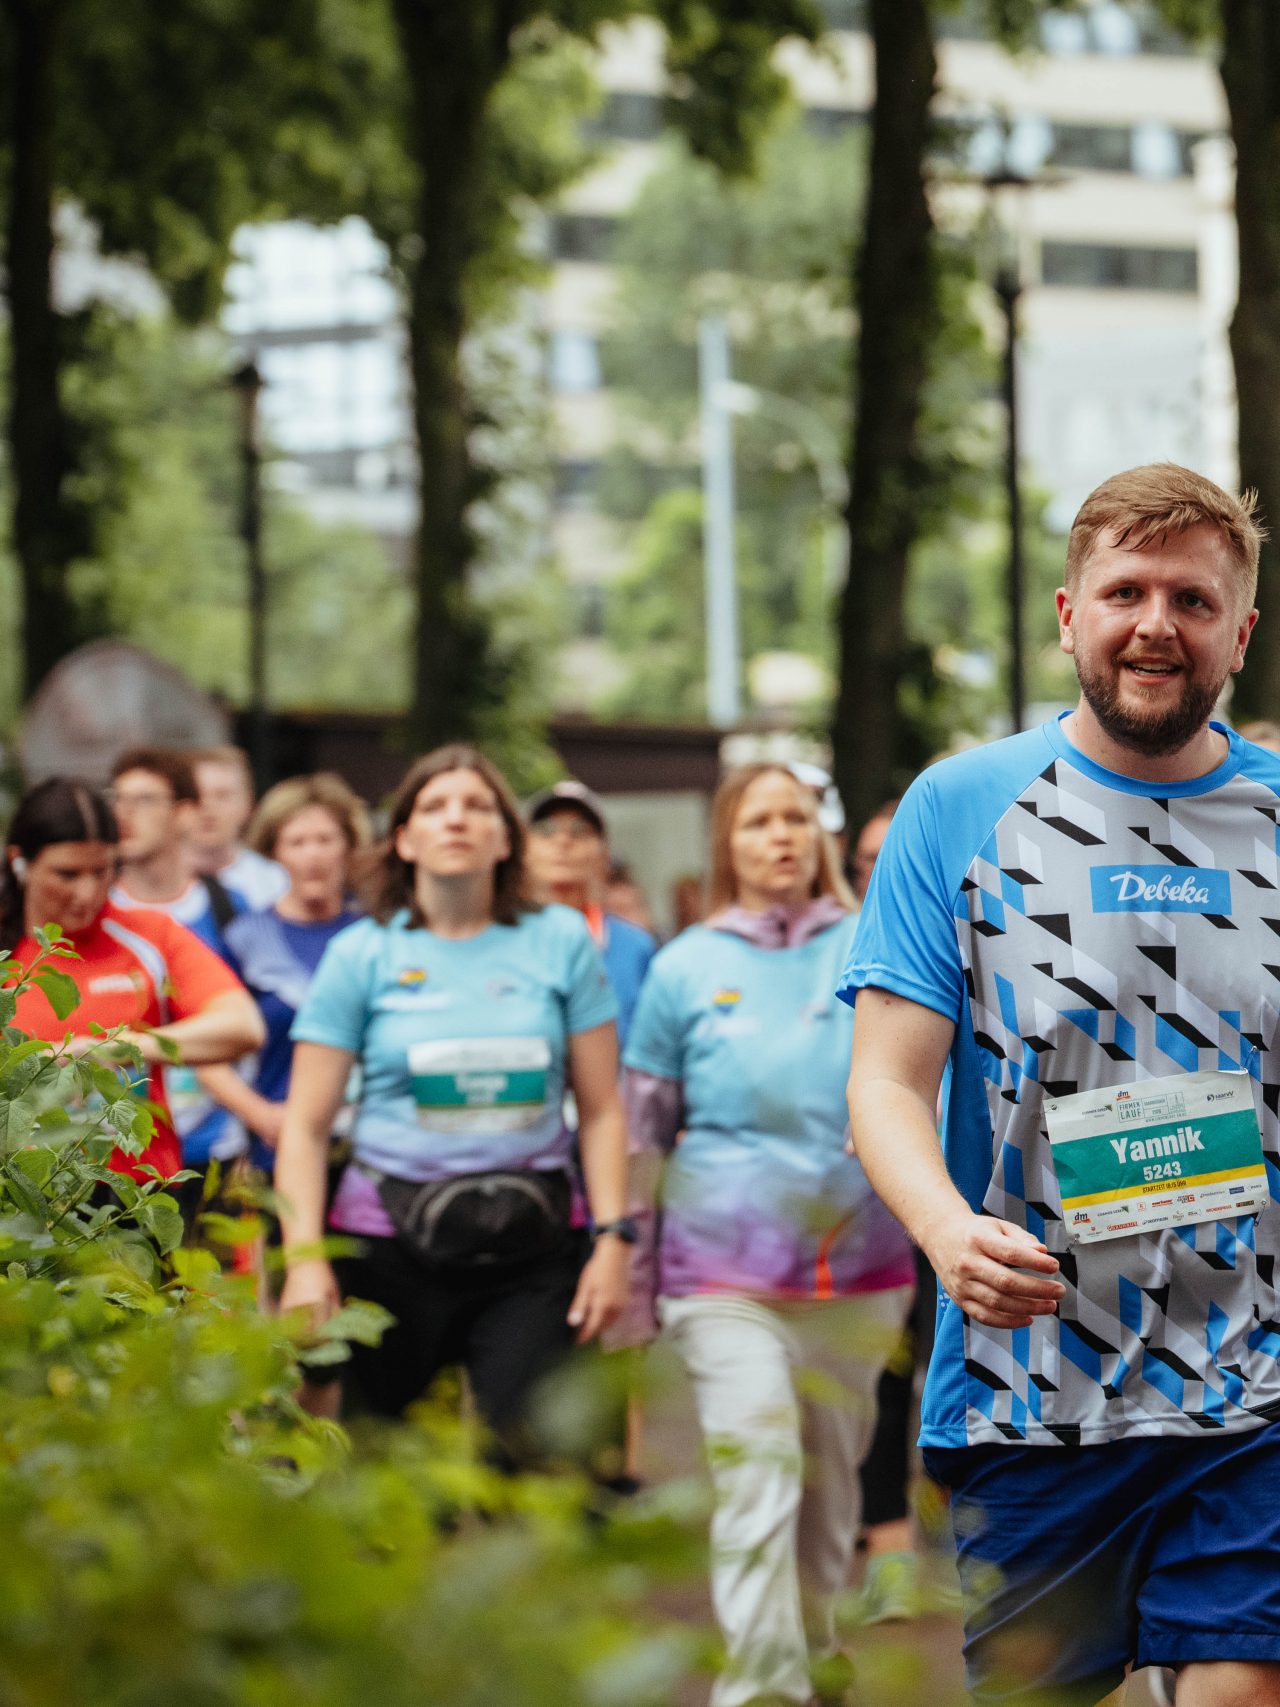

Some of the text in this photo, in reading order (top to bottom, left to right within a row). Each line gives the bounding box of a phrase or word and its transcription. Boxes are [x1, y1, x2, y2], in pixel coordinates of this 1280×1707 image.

[1109, 871, 1210, 904] Debeka
[1117, 1090, 1129, 1098] dm
[1120, 1109, 1141, 1120] LAUF
[1110, 1126, 1205, 1164] Yannik
[1143, 1161, 1182, 1182] 5243
[1074, 1211, 1088, 1221] dm
